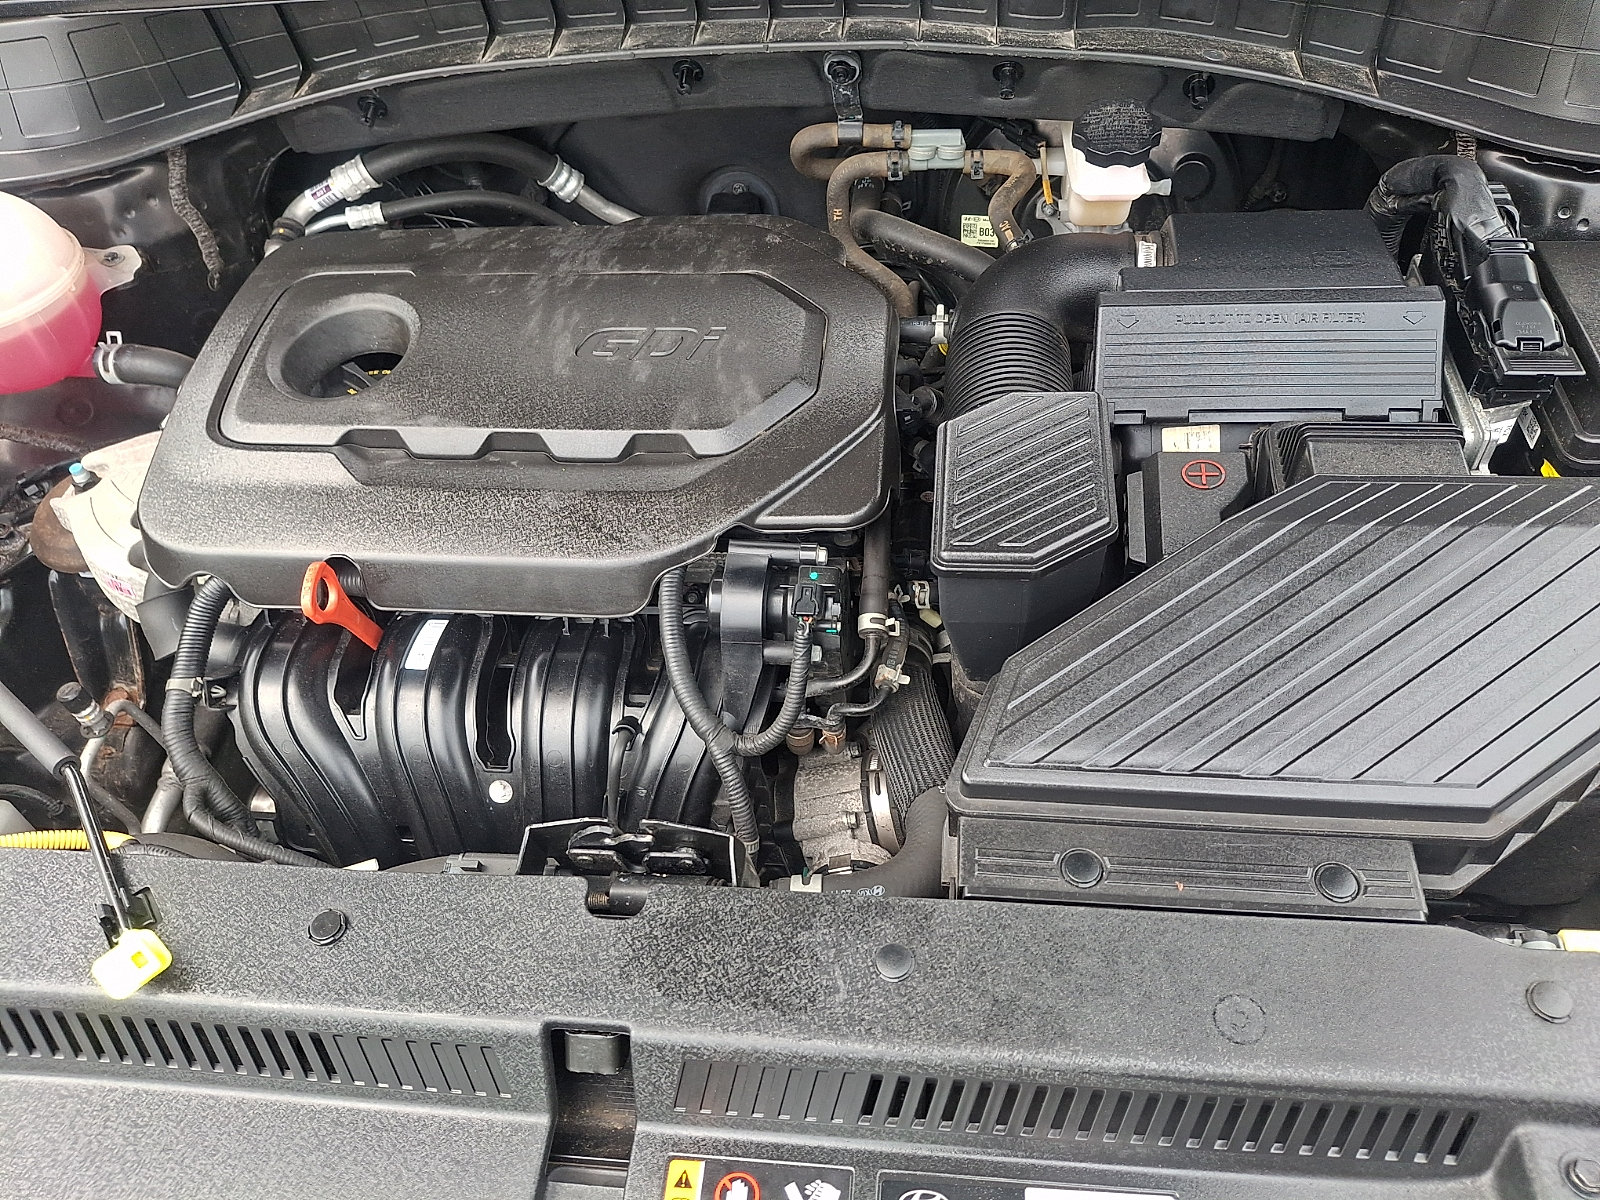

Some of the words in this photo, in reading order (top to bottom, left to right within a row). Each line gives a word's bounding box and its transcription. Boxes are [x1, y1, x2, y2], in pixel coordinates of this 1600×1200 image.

[1175, 314, 1206, 325] PULL
[1209, 313, 1233, 324] OUT
[1236, 313, 1251, 324] TO
[1255, 312, 1288, 324] OPEN
